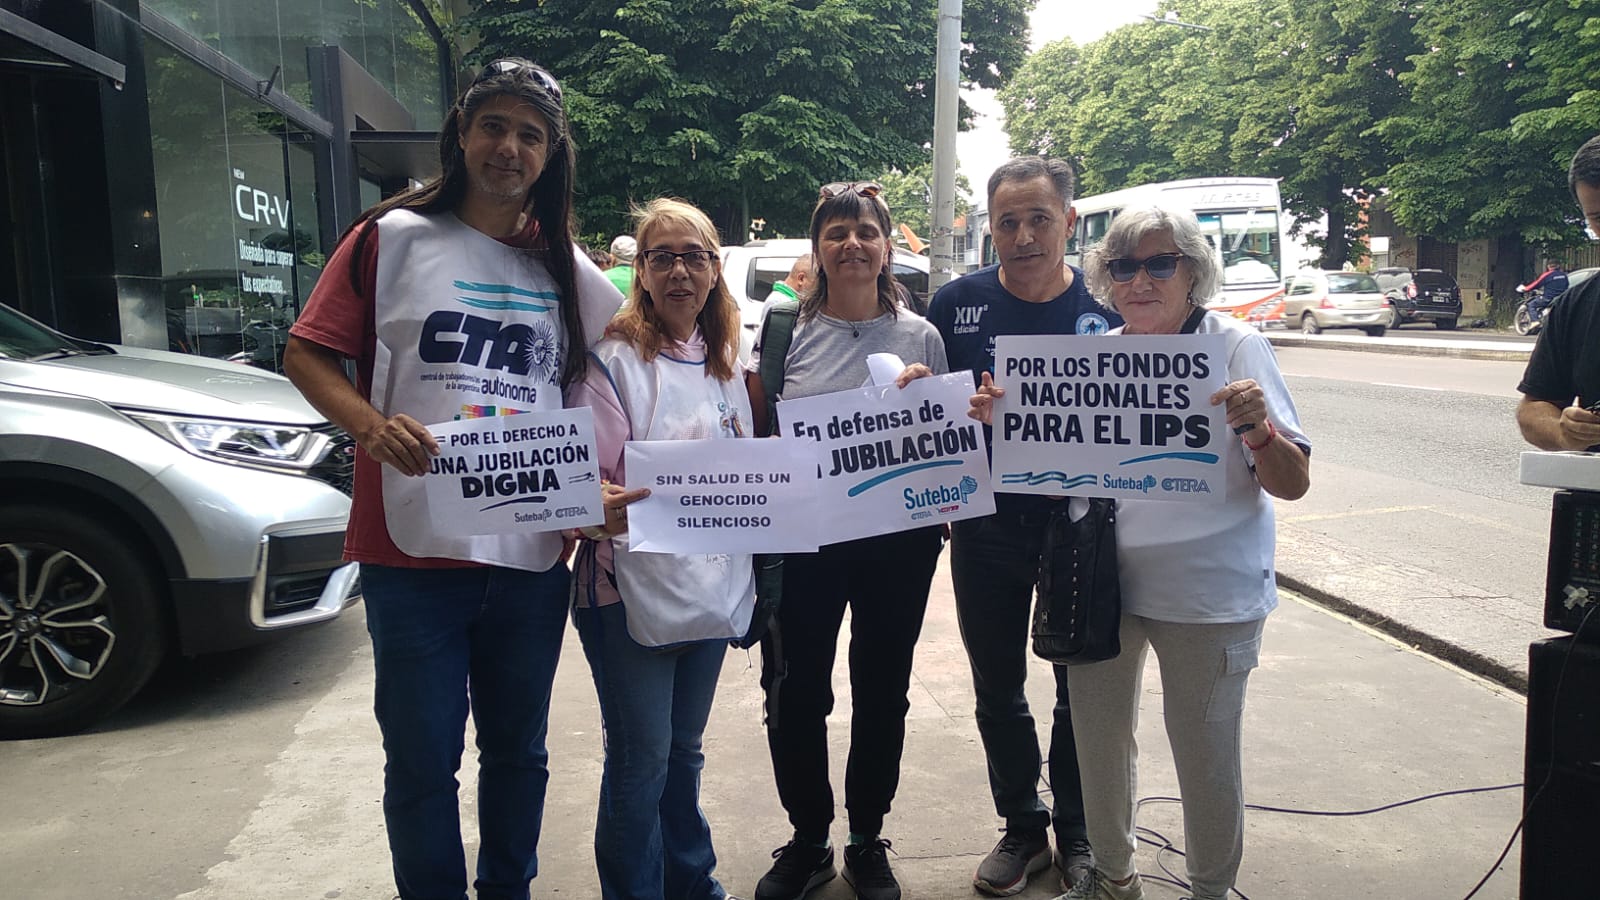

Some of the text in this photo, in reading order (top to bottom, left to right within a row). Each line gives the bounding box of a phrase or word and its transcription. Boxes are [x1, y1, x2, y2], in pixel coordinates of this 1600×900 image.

[418, 310, 536, 376] CTA
[953, 325, 980, 335] Edición
[1005, 357, 1047, 378] POR
[1052, 357, 1091, 378] LOS
[1097, 352, 1210, 380] FONDOS
[481, 376, 537, 404] autónoma
[1020, 382, 1191, 410] NACIONALES
[827, 407, 914, 440] defensa
[918, 399, 945, 424] de
[1003, 412, 1211, 449] PARA EL IPS
[450, 423, 578, 447] POR EL DERECHO A
[829, 420, 978, 477] JUBILACIÓN
[430, 441, 590, 475] UNA JUBILACIÓN
[461, 468, 561, 499] DIGNA
[655, 473, 791, 485] SIN SALUD ES UN
[1103, 473, 1211, 493] Suteba CTERA
[680, 494, 768, 506] GENOCIDIO
[903, 484, 960, 511] Suteba
[514, 505, 589, 523] Suteba CTERA
[677, 516, 771, 528] SILENCIOSO
